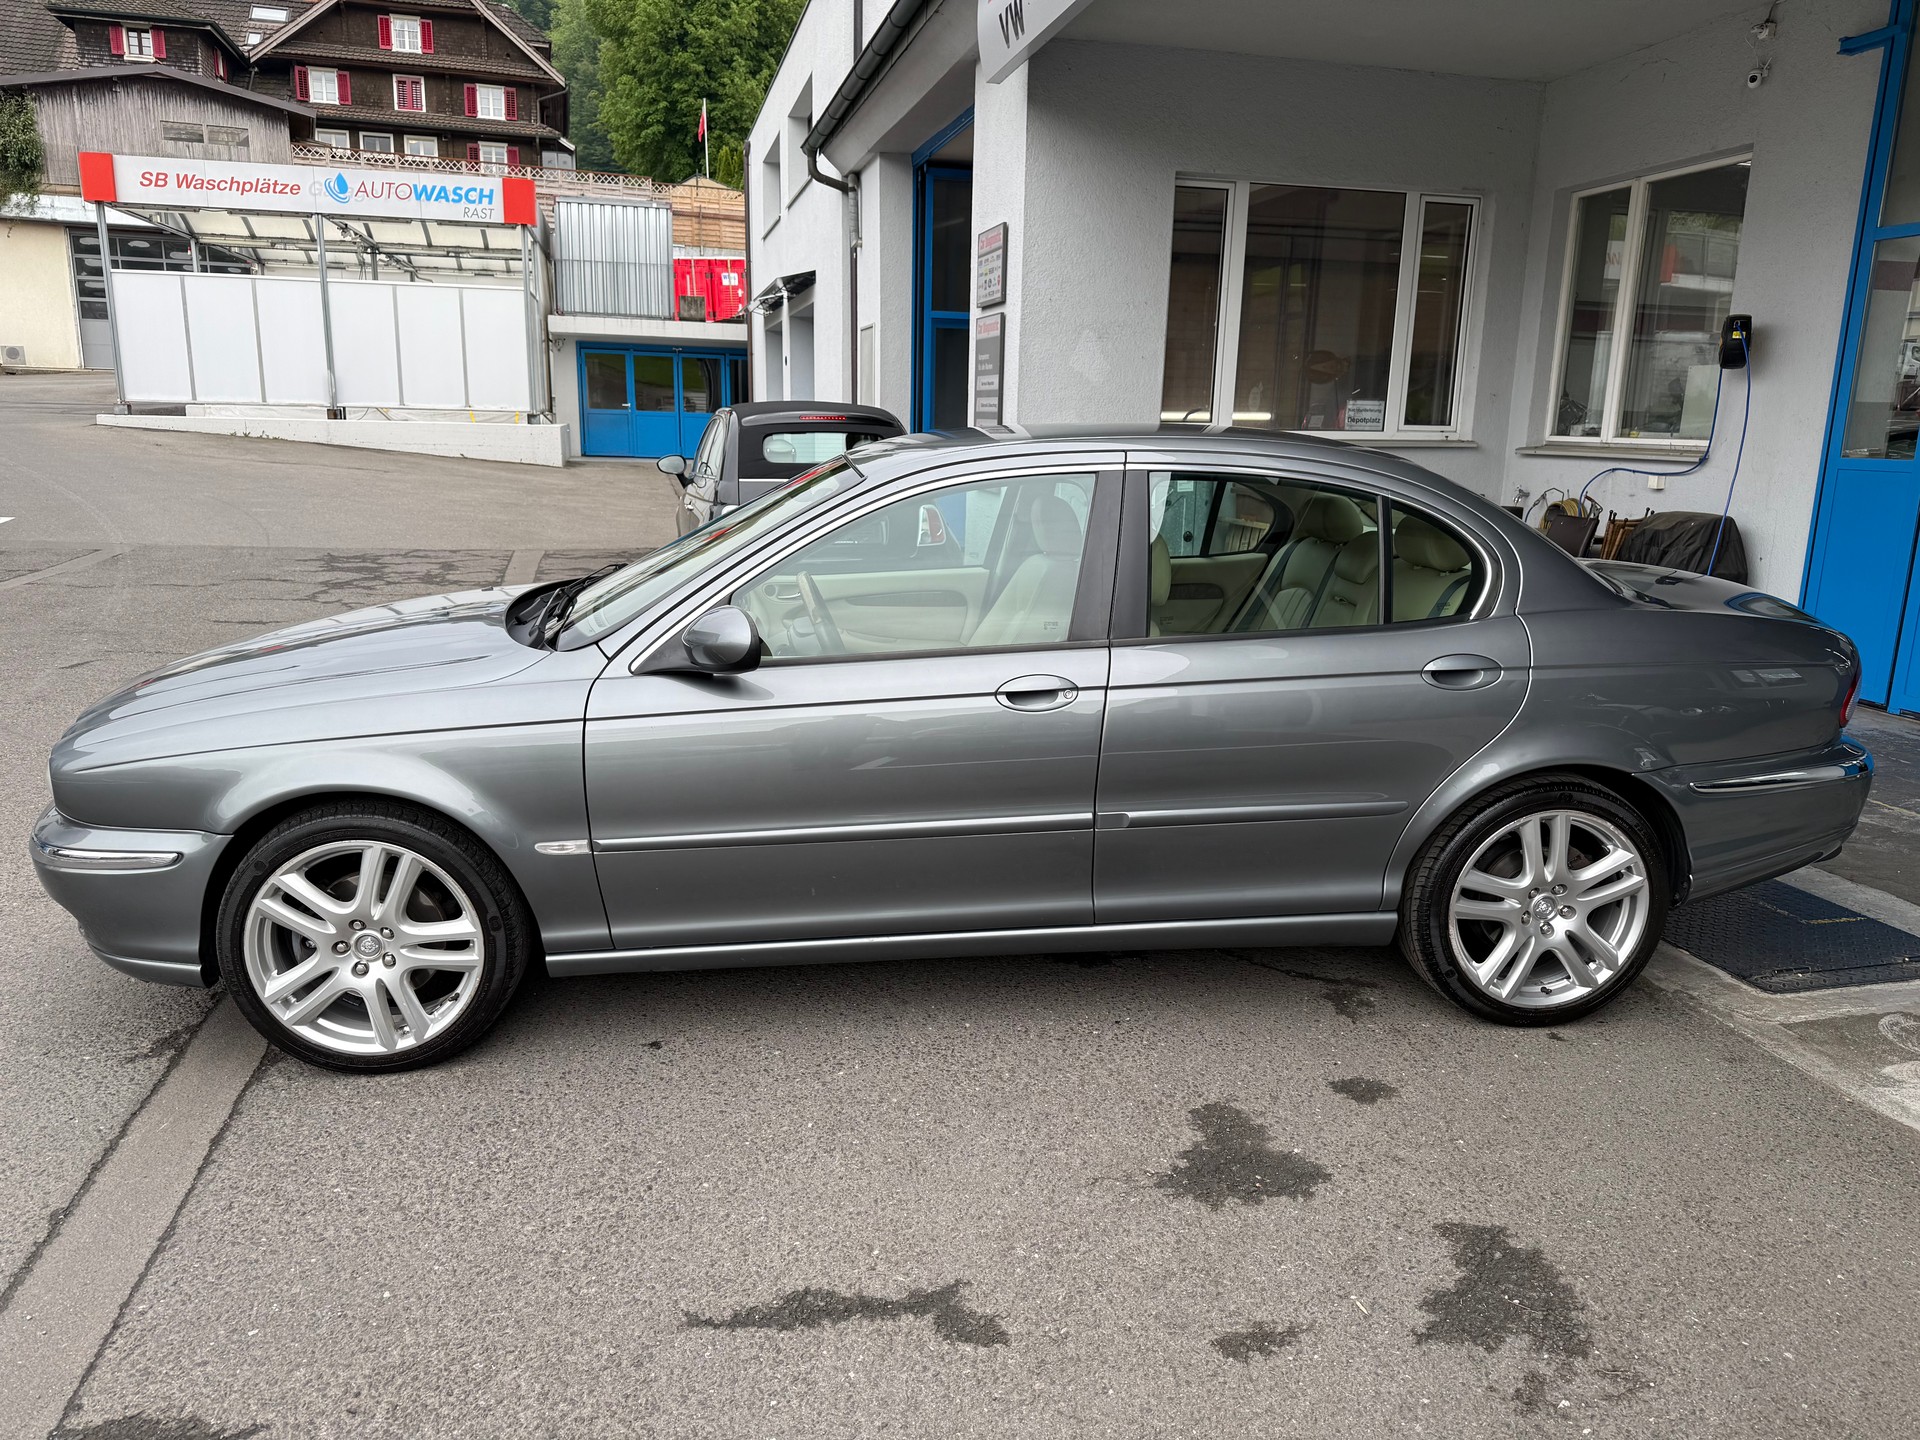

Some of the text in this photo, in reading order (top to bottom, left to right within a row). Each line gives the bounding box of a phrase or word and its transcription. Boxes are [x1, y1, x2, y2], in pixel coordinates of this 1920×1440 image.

[998, 0, 1025, 49] VW
[139, 171, 169, 189] SB
[175, 173, 301, 196] Waschplätze
[354, 180, 495, 206] AUTOWASCH
[462, 206, 496, 220] RAST
